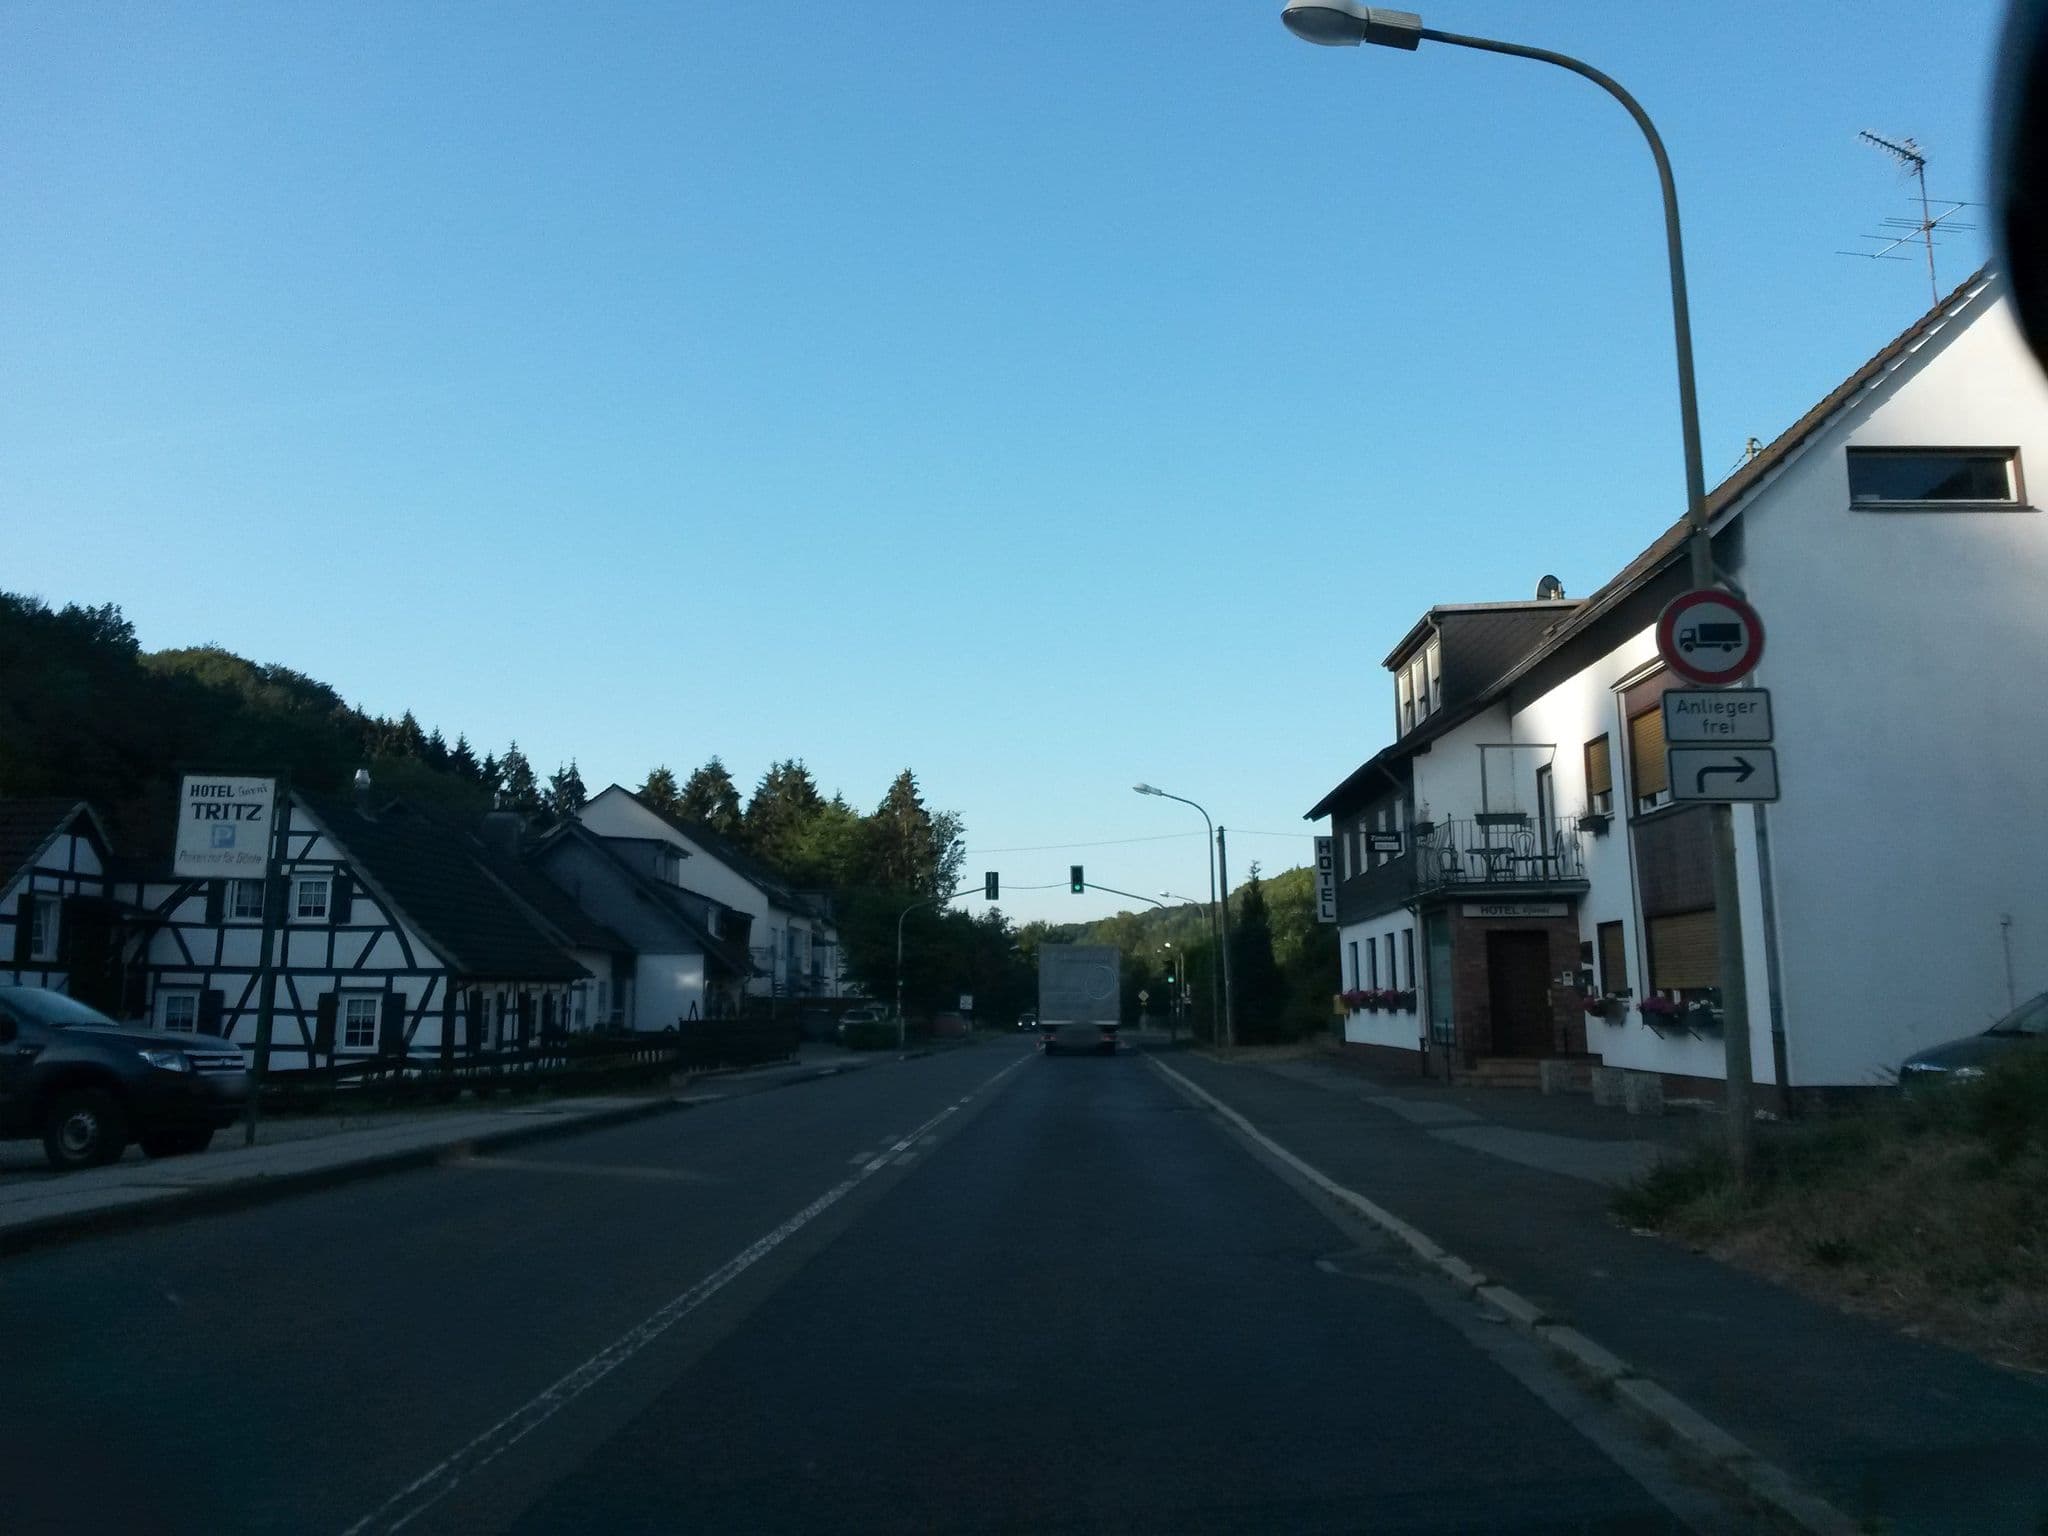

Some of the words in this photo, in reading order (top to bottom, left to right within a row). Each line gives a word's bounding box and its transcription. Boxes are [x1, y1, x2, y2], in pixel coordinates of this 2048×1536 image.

[1676, 699, 1758, 717] Anlieger
[1702, 718, 1736, 734] frei
[190, 784, 235, 798] HOTEL
[191, 802, 264, 821] TRITZ
[213, 826, 232, 848] P
[1318, 839, 1334, 918] HOTEL
[1480, 904, 1520, 915] HOTEL
